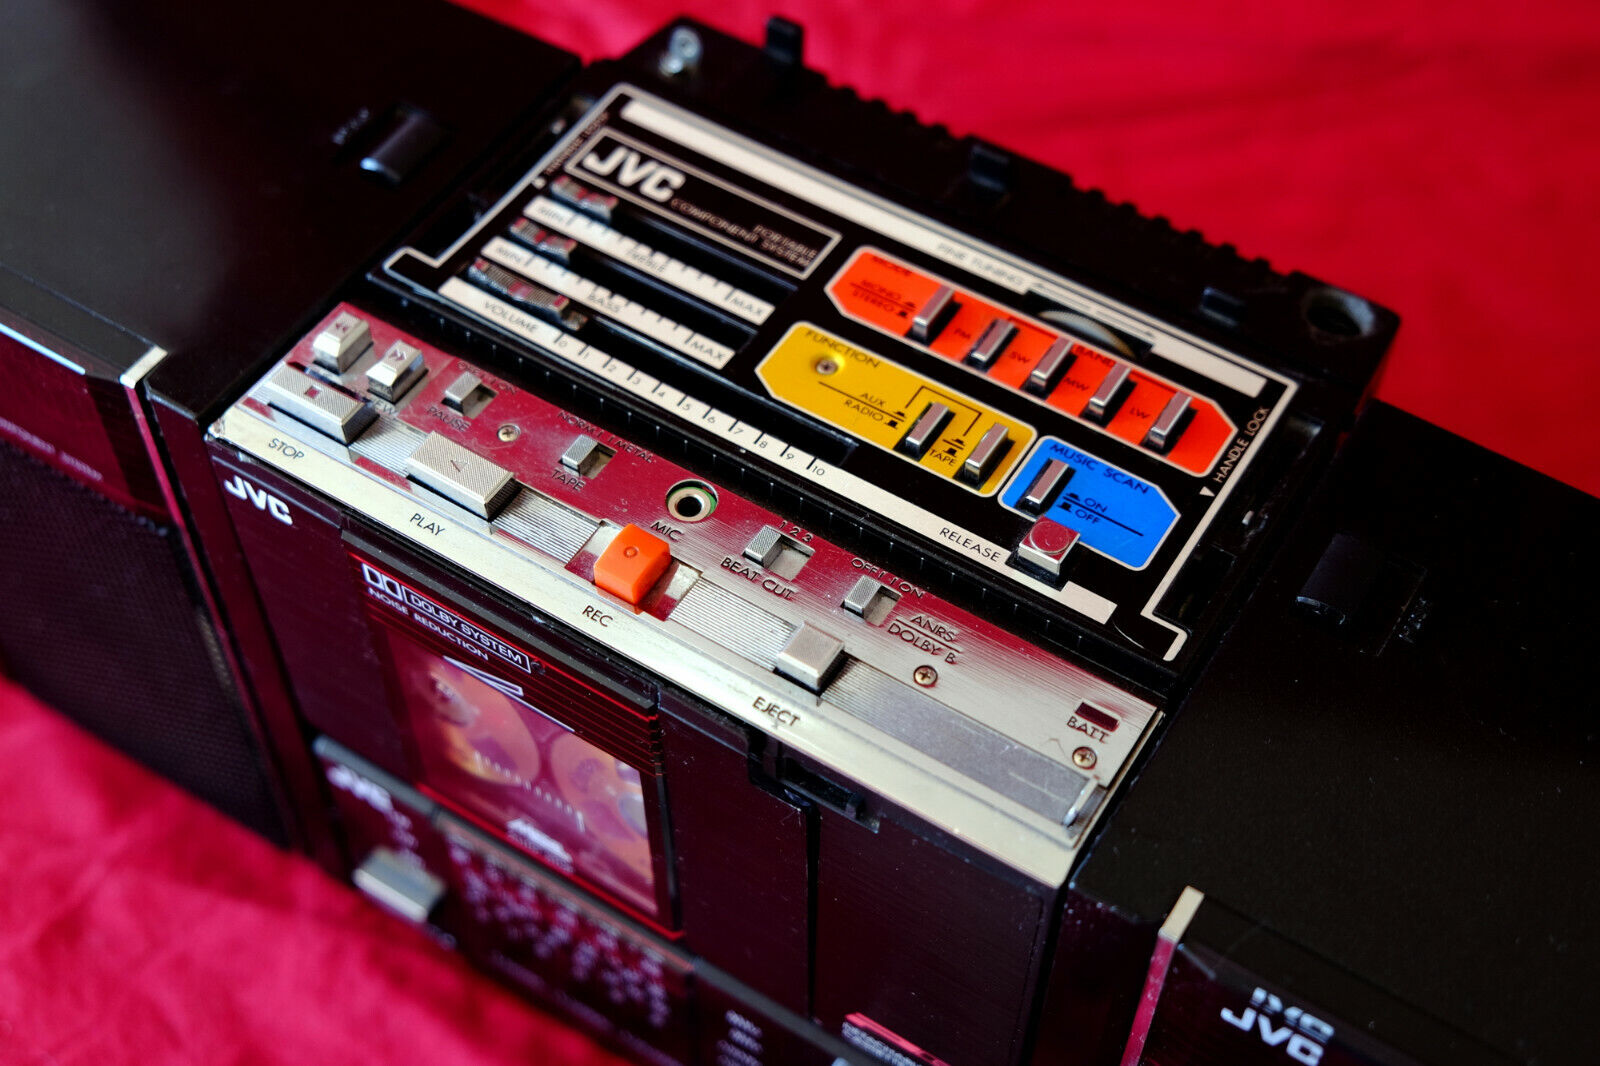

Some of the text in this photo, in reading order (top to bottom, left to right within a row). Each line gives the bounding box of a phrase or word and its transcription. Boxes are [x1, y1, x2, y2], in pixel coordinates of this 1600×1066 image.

[582, 145, 686, 202] JVC
[731, 296, 764, 316] MAX
[853, 290, 894, 312] STEREO
[588, 293, 620, 313] BASS
[691, 338, 726, 361] MAX
[804, 329, 881, 368] FUNCTION
[1074, 344, 1116, 368] BAND
[484, 300, 538, 332] VOLUME
[608, 363, 617, 372] 2
[632, 376, 641, 385] 3
[657, 390, 666, 398] 4
[681, 403, 690, 411] 5
[707, 415, 716, 424] 6
[734, 427, 744, 436] 7
[759, 440, 767, 449] 8
[786, 453, 795, 461] 9
[812, 465, 825, 477] 10
[954, 327, 1150, 420] FM SW MW LW
[843, 399, 885, 422] RADIO
[859, 391, 887, 408] AUX
[427, 405, 472, 432] PAUSE
[268, 438, 305, 460] STOP
[557, 409, 654, 464] NORM METAL
[1213, 406, 1271, 484] HANDLE LOCK
[927, 448, 957, 467] TAPE
[1049, 442, 1150, 495] MUSIC SCAN
[551, 469, 587, 492] TAPE
[223, 475, 294, 526] JVC
[1084, 497, 1108, 512] ON
[410, 512, 446, 537] PLAY
[1074, 508, 1101, 525] OFF
[650, 521, 685, 543] MIC
[790, 526, 802, 537] 2
[802, 533, 813, 544] 3
[939, 527, 1002, 563] RELEASE
[720, 556, 799, 601] BEAT CUT
[851, 557, 926, 599] OFF ON
[367, 586, 489, 662] NOISE REDUCTION
[410, 594, 523, 665] DOLBY SYSTEM
[582, 605, 613, 628] REC
[911, 614, 958, 642] ANRS
[887, 622, 958, 665] DOLBY B
[752, 696, 801, 728] EJECT
[1066, 716, 1111, 744] BATT
[1219, 1006, 1325, 1066] JVC
